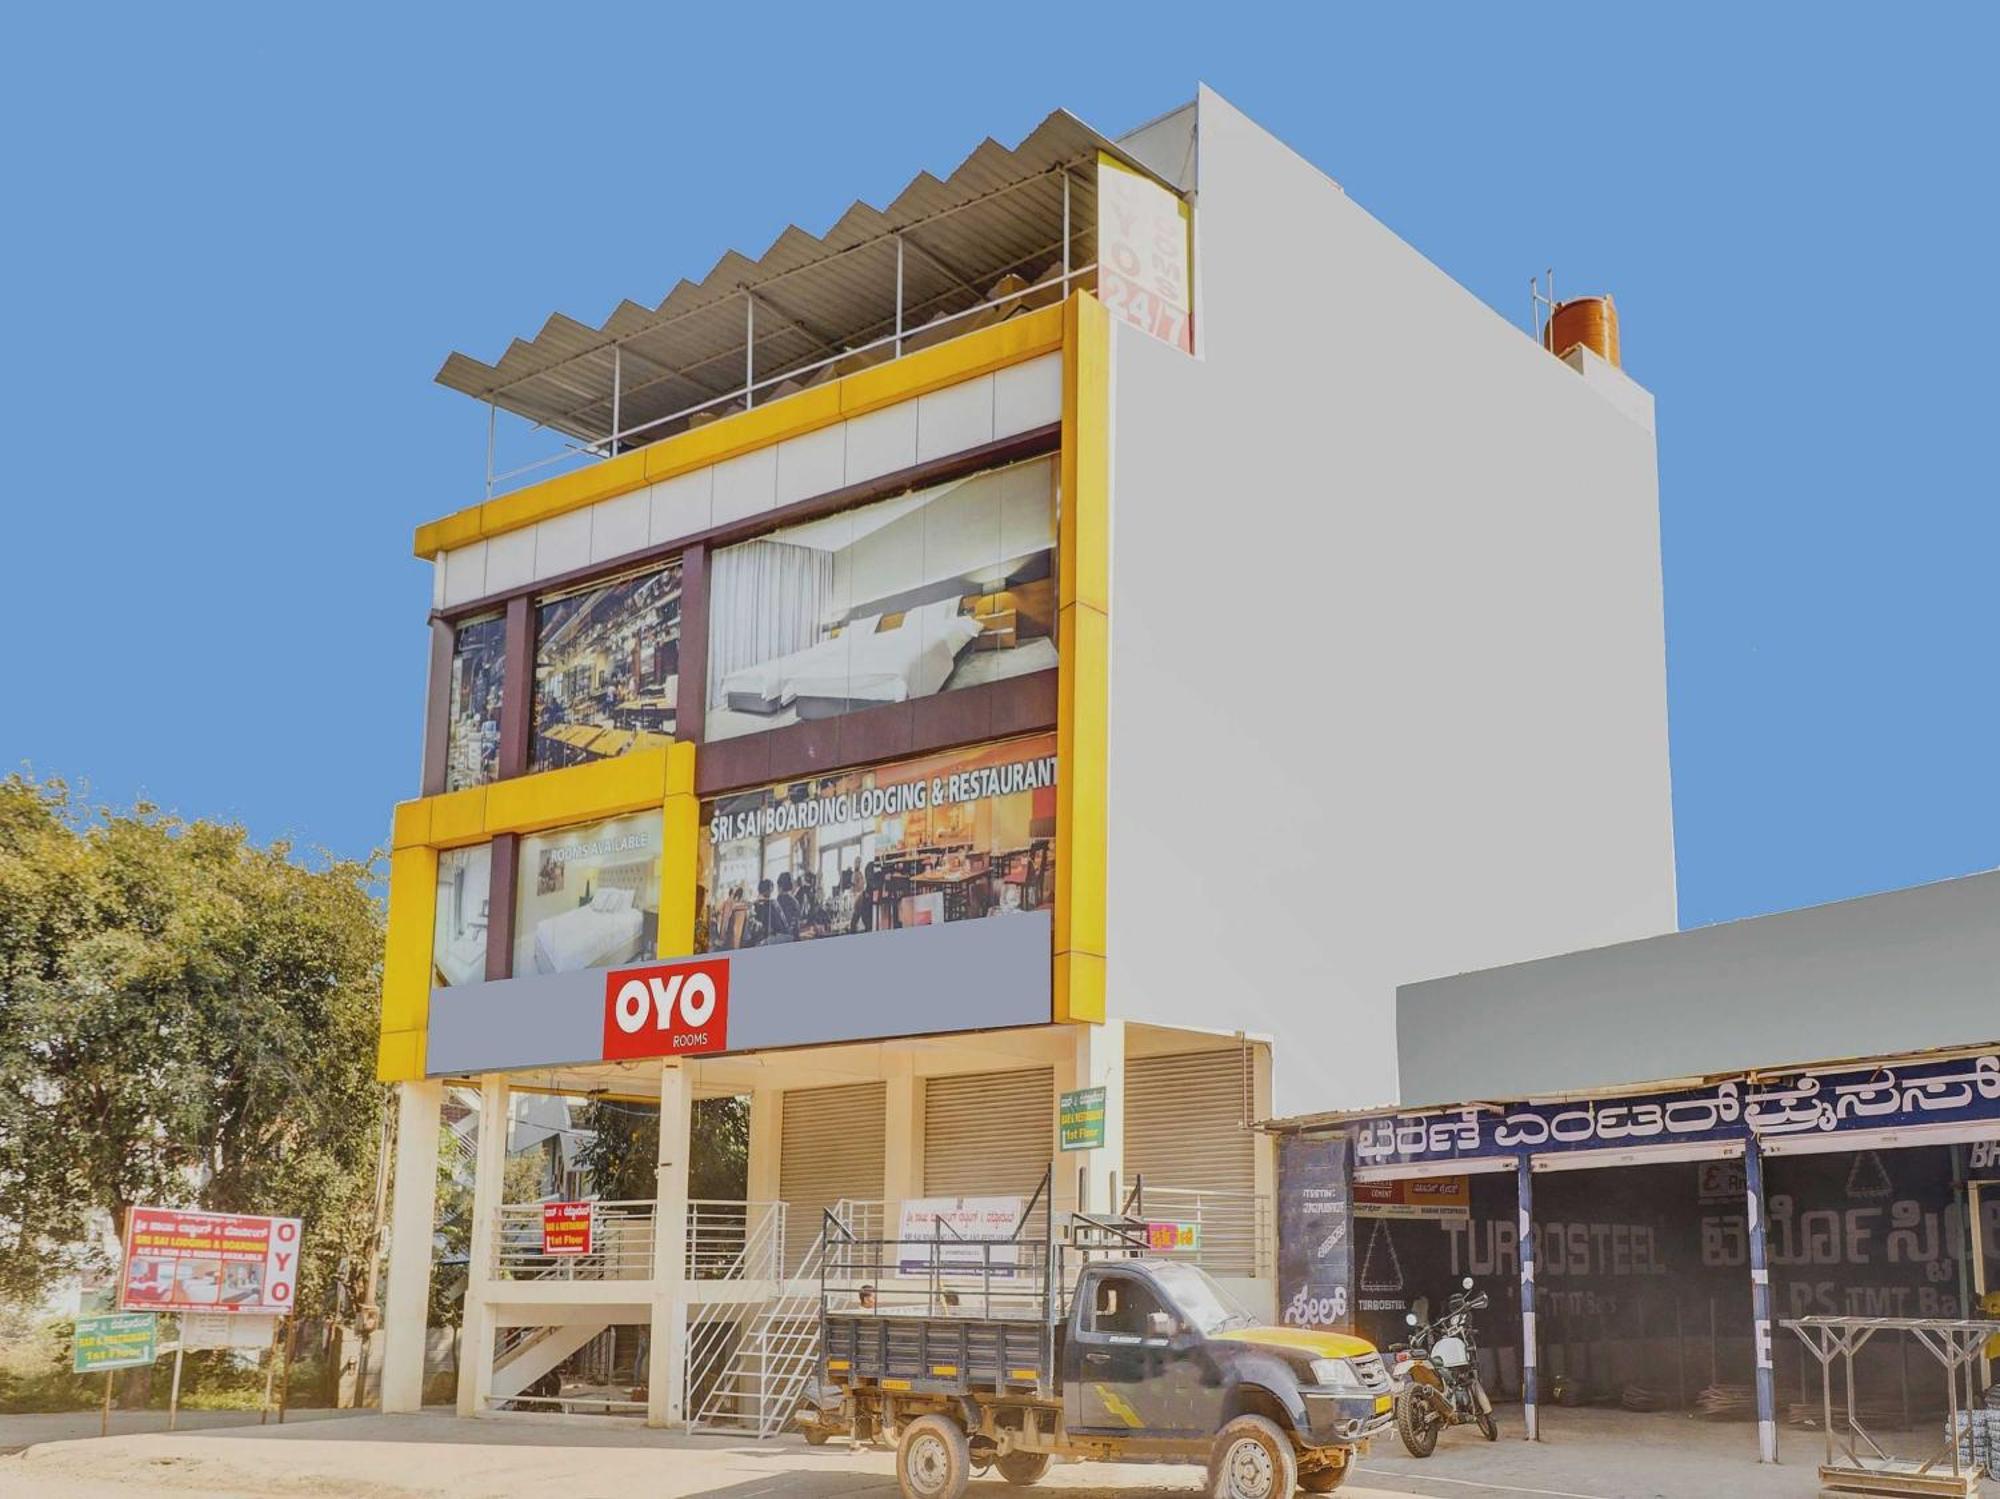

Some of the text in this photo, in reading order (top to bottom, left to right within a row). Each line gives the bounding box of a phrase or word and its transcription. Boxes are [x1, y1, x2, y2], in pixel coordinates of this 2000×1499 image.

[709, 756, 1058, 844] SRI SAI BOARDING LODGING & RESTAURANT
[591, 831, 649, 855] AVAILABLE
[614, 971, 717, 1034] OYO
[672, 1031, 709, 1049] ROOMS
[270, 1223, 297, 1303] OYO
